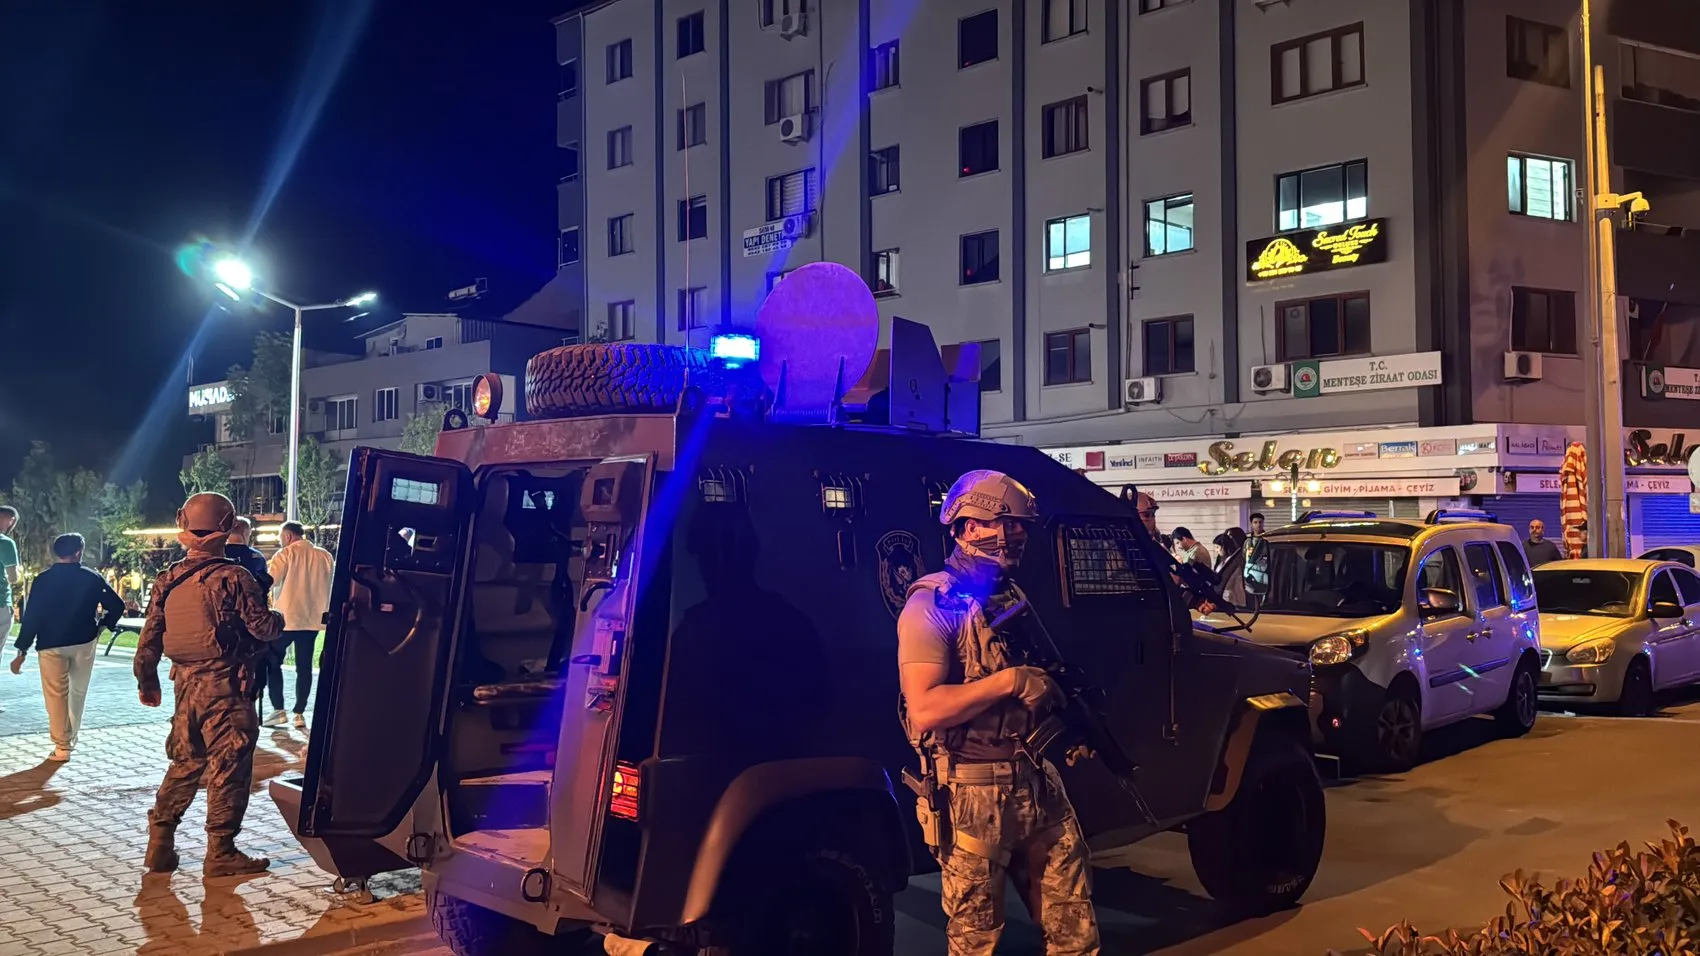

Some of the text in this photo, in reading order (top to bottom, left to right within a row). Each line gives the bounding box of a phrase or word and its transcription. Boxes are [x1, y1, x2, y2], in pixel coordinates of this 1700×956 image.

[761, 230, 783, 244] DENET
[1348, 223, 1379, 241] Touch
[1369, 360, 1388, 372] T.C.
[1323, 369, 1438, 389] MENTEŞE ZİRAAT ODASI
[1197, 440, 1342, 476] Selen
[1283, 486, 1308, 494] SEEN
[1324, 485, 1350, 493] GİYİM
[1359, 484, 1396, 493] PİJAMA
[1406, 484, 1435, 493] ÇEYİZ
[1539, 480, 1561, 489] SELE
[1647, 480, 1670, 490] ÇEYİZ
[1161, 486, 1195, 497] PİJAMA
[1203, 486, 1230, 496] ÇEYİZ
